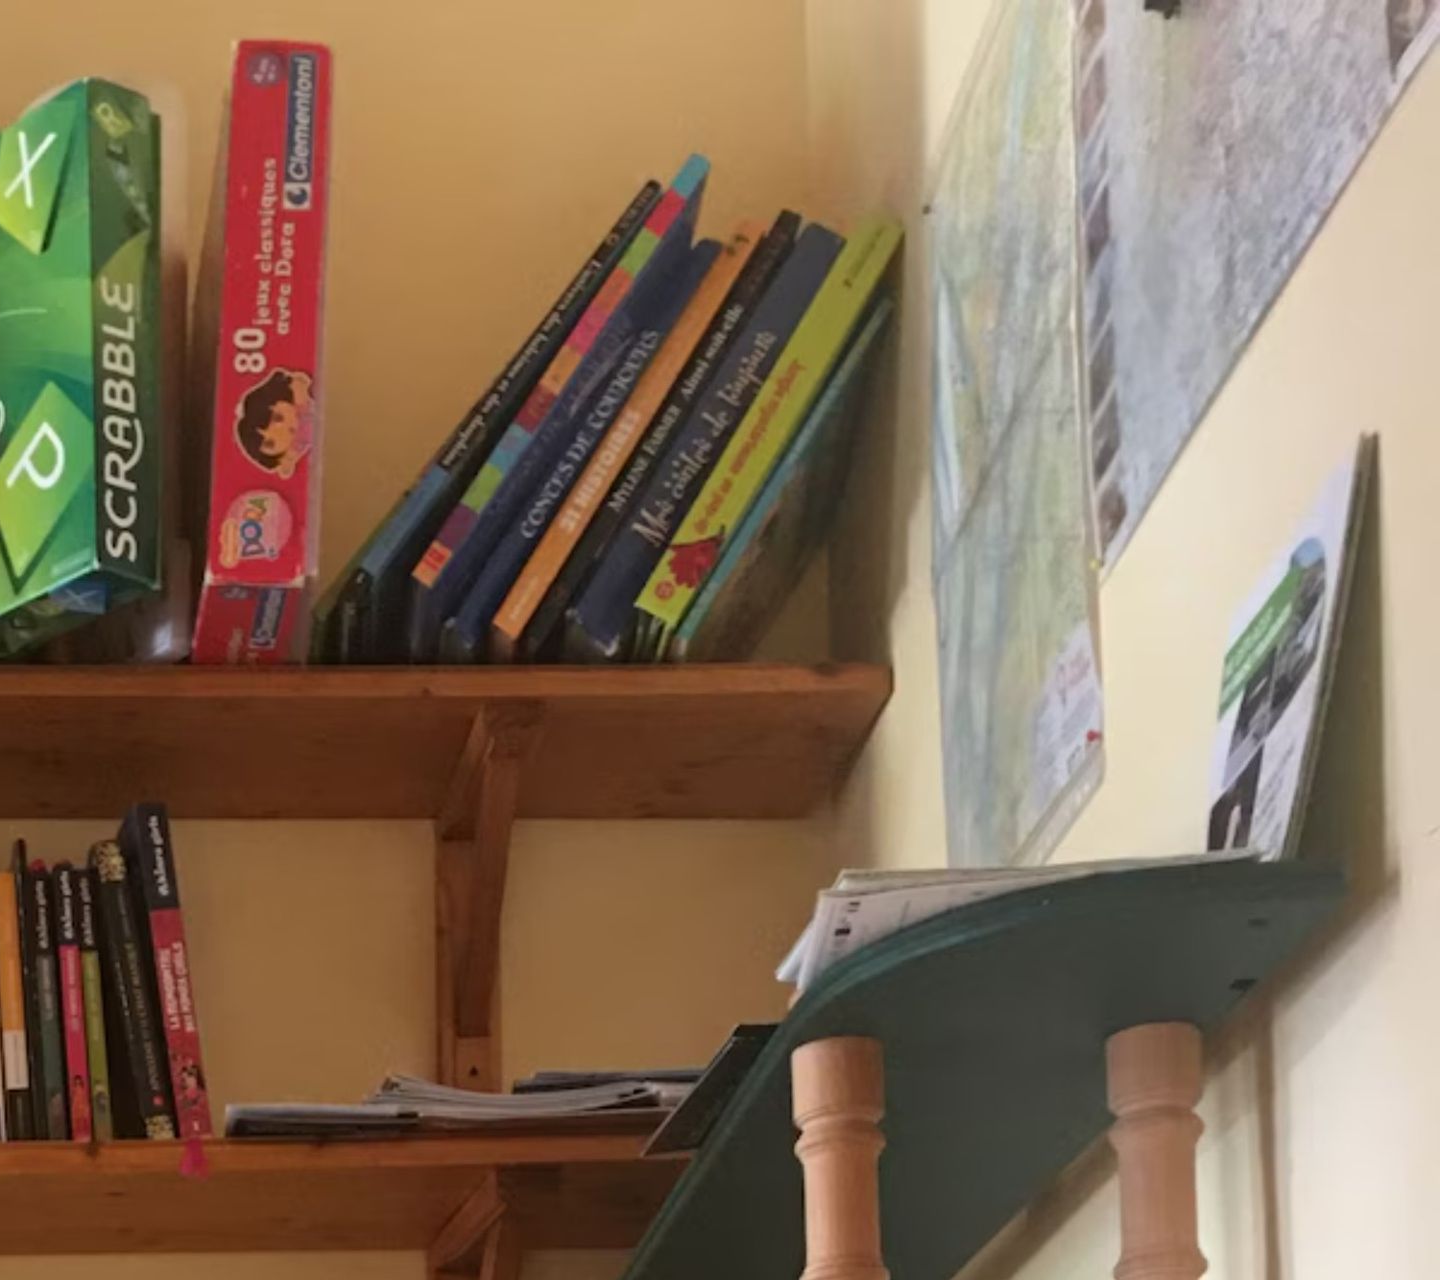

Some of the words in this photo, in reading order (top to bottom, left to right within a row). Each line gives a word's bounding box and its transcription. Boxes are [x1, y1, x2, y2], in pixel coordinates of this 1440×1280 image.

[287, 56, 317, 181] Clementoni
[5, 132, 57, 208] X
[257, 157, 278, 258] classiques
[273, 222, 296, 273] Dora
[255, 263, 273, 327] jeux
[275, 278, 291, 335] avec
[234, 328, 266, 374] 80
[99, 275, 145, 563] SCRABBLE
[642, 404, 683, 458] FARMER
[699, 410, 731, 440] de
[6, 421, 67, 490] P
[520, 459, 576, 539] CONTES
[564, 430, 592, 461] DE
